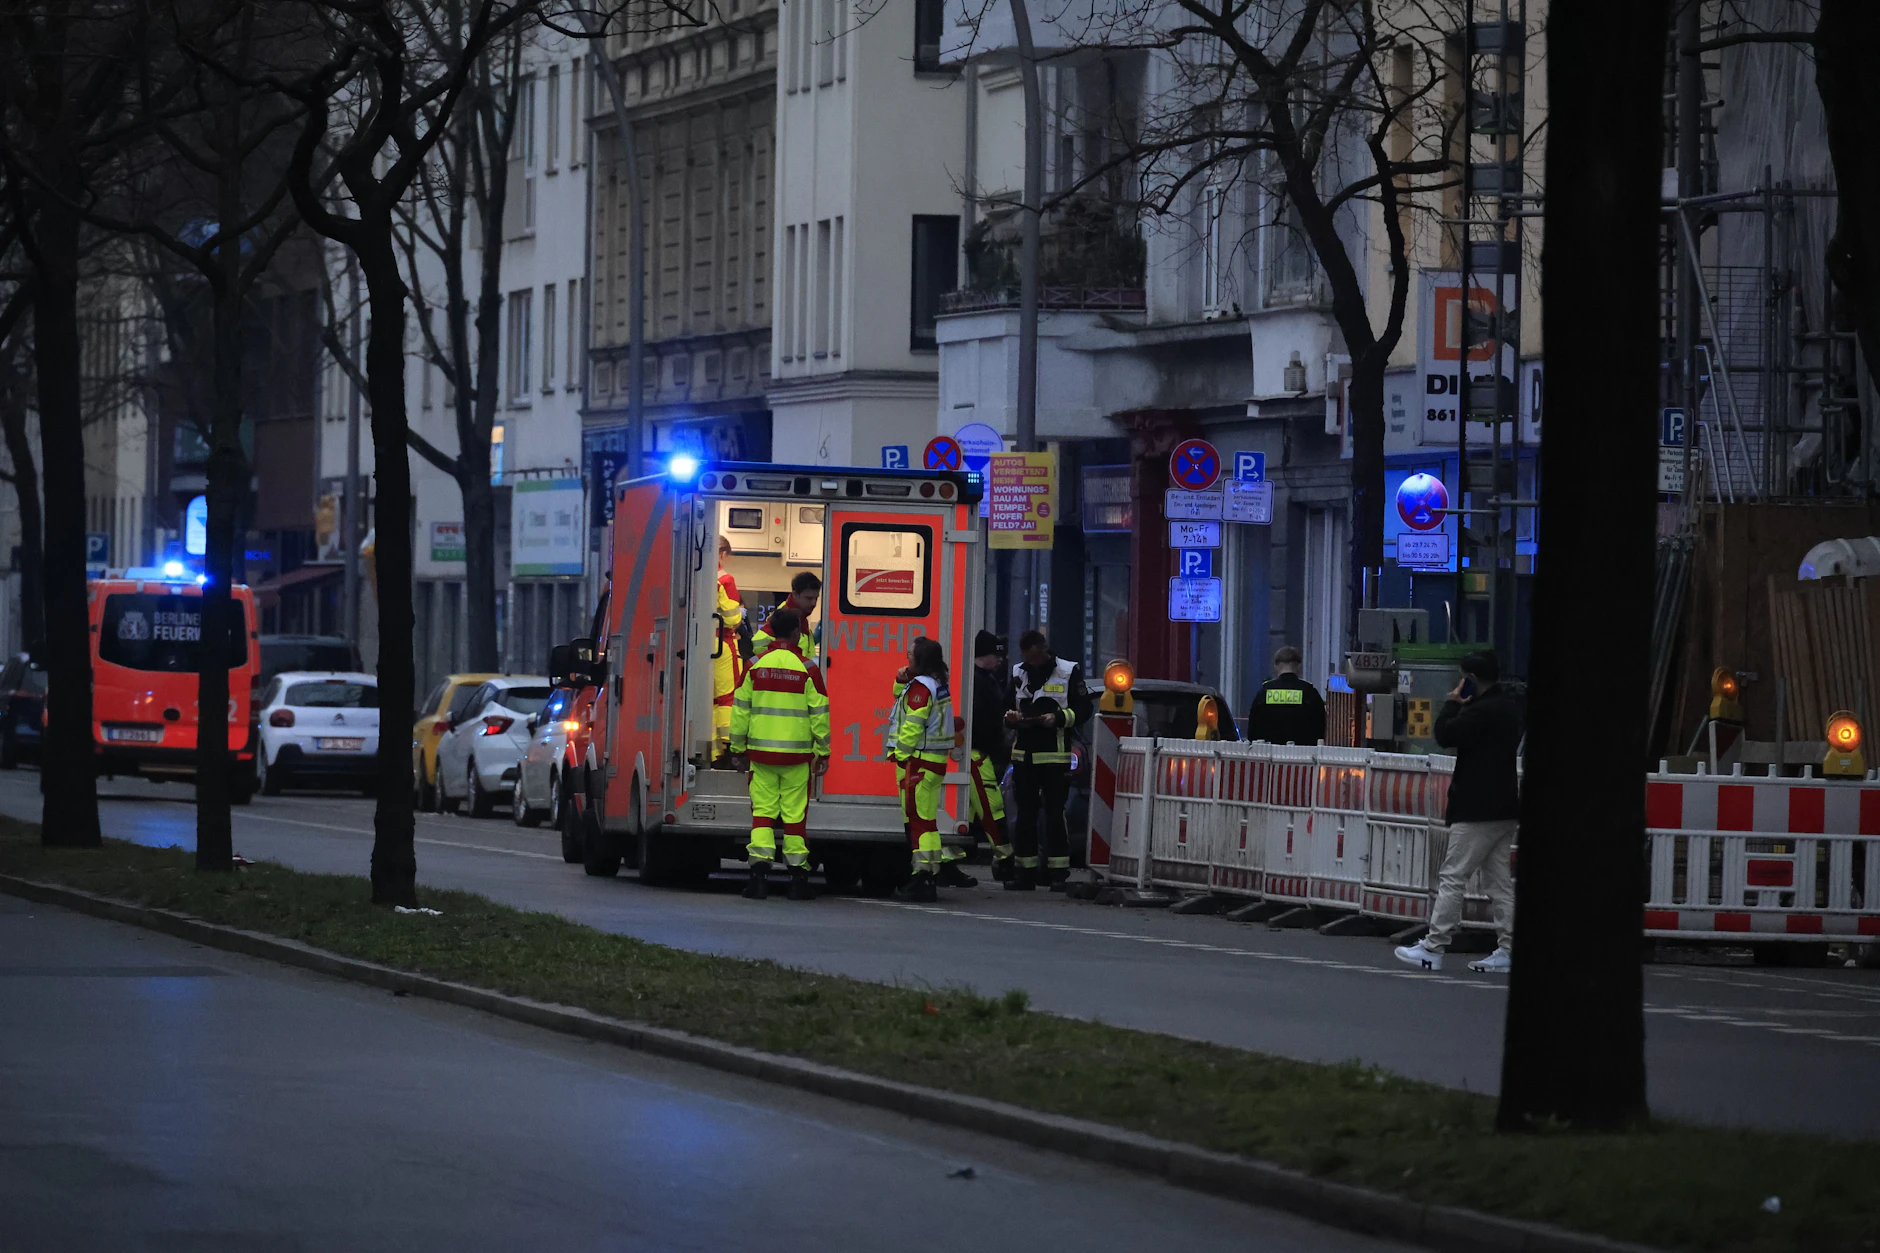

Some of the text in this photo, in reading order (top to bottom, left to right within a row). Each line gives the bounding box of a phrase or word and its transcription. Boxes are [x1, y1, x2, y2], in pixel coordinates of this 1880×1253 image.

[1426, 408, 1456, 421] 861
[1669, 412, 1685, 441] P
[885, 448, 901, 468] P
[993, 459, 1024, 467] AUTOS
[1239, 455, 1256, 479] P
[993, 467, 1045, 476] VERBIETEN?
[993, 476, 1016, 484] NEIN!
[993, 485, 1047, 494] WOHNUNGS-
[993, 494, 1027, 502] BAU AM
[993, 503, 1030, 512] TEMPEL-
[993, 512, 1023, 520] HOFER
[993, 521, 1035, 529] FELD? JA!
[1180, 524, 1209, 533] Mo-Fr
[1183, 535, 1208, 544] 7-14h
[87, 536, 104, 558] P
[1185, 551, 1202, 575] P
[1354, 654, 1388, 669] 4837
[770, 672, 801, 682] FEUERWEHR
[1267, 691, 1303, 703] POLIZEI
